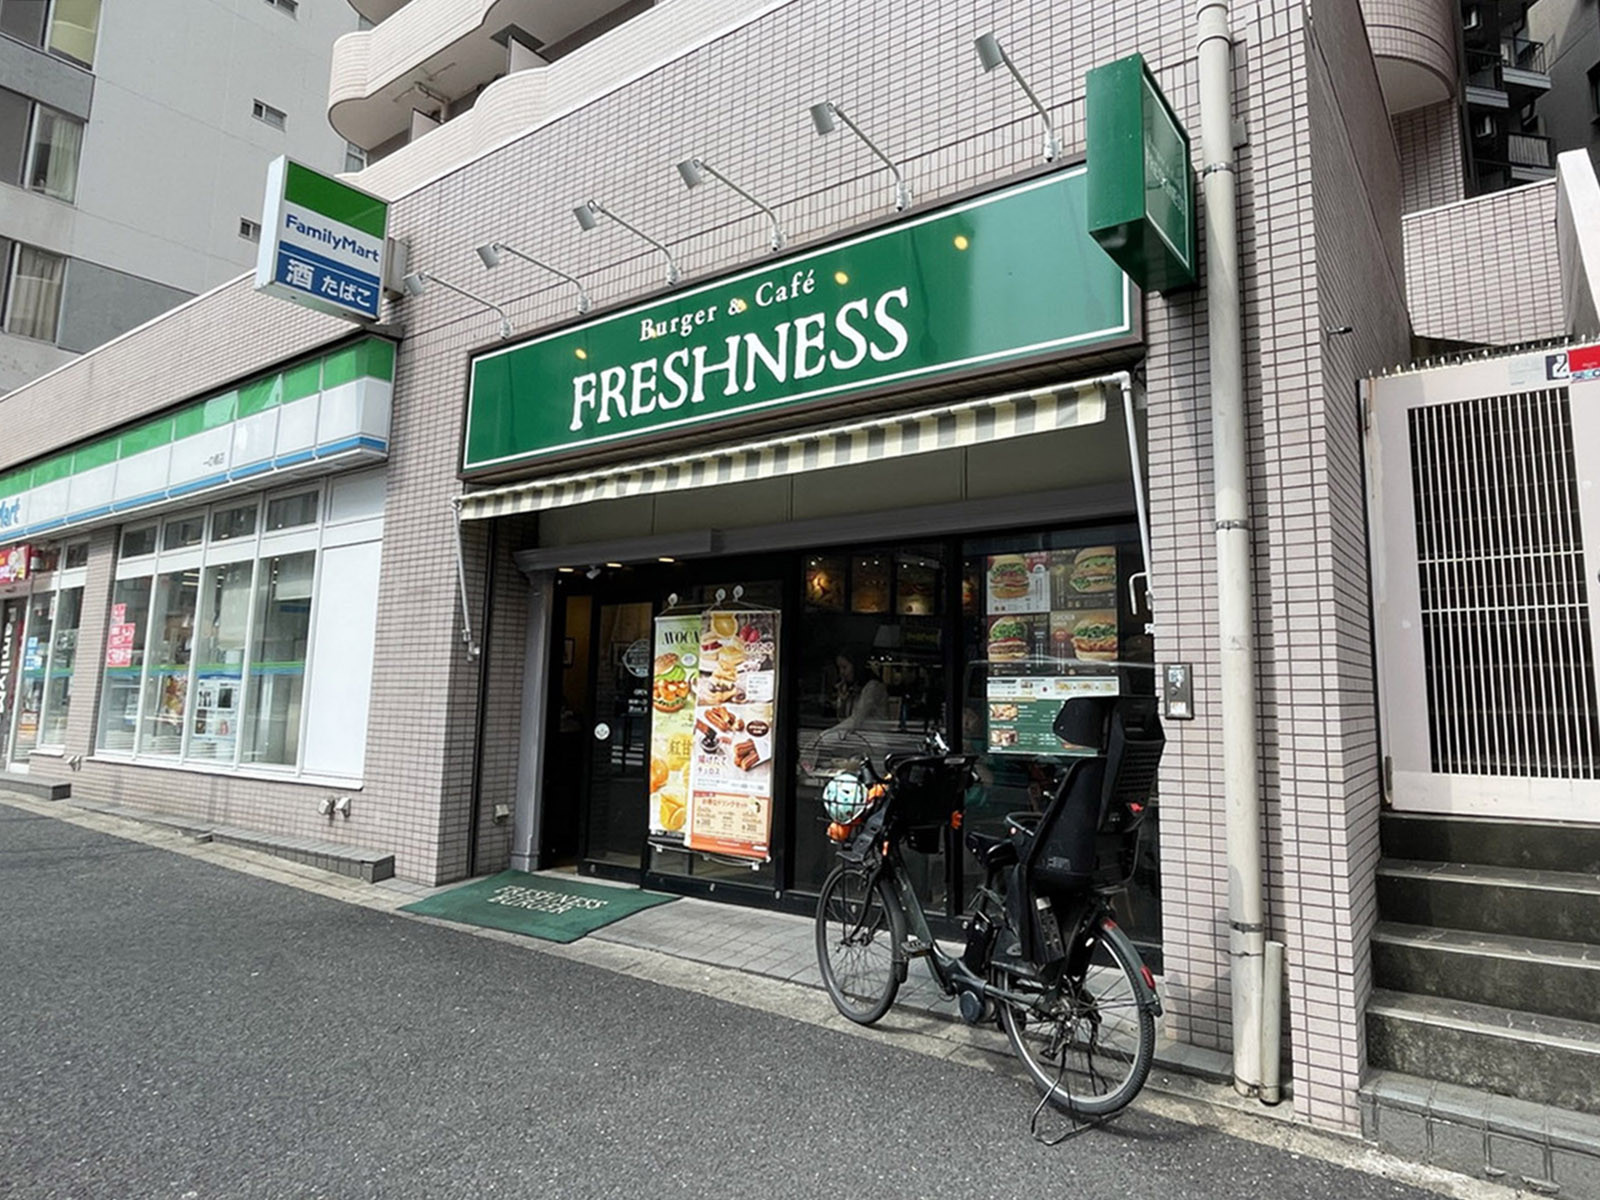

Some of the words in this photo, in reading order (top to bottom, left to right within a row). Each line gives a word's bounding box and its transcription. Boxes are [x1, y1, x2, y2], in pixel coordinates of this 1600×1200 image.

[286, 214, 379, 262] FamilyMart
[285, 258, 315, 290] 酒
[321, 275, 371, 307] たばこ
[639, 303, 718, 342] Burger
[728, 297, 747, 316] &
[755, 269, 816, 308] Café
[569, 287, 910, 431] FRESHNESS
[494, 885, 609, 910] FRESHNESS
